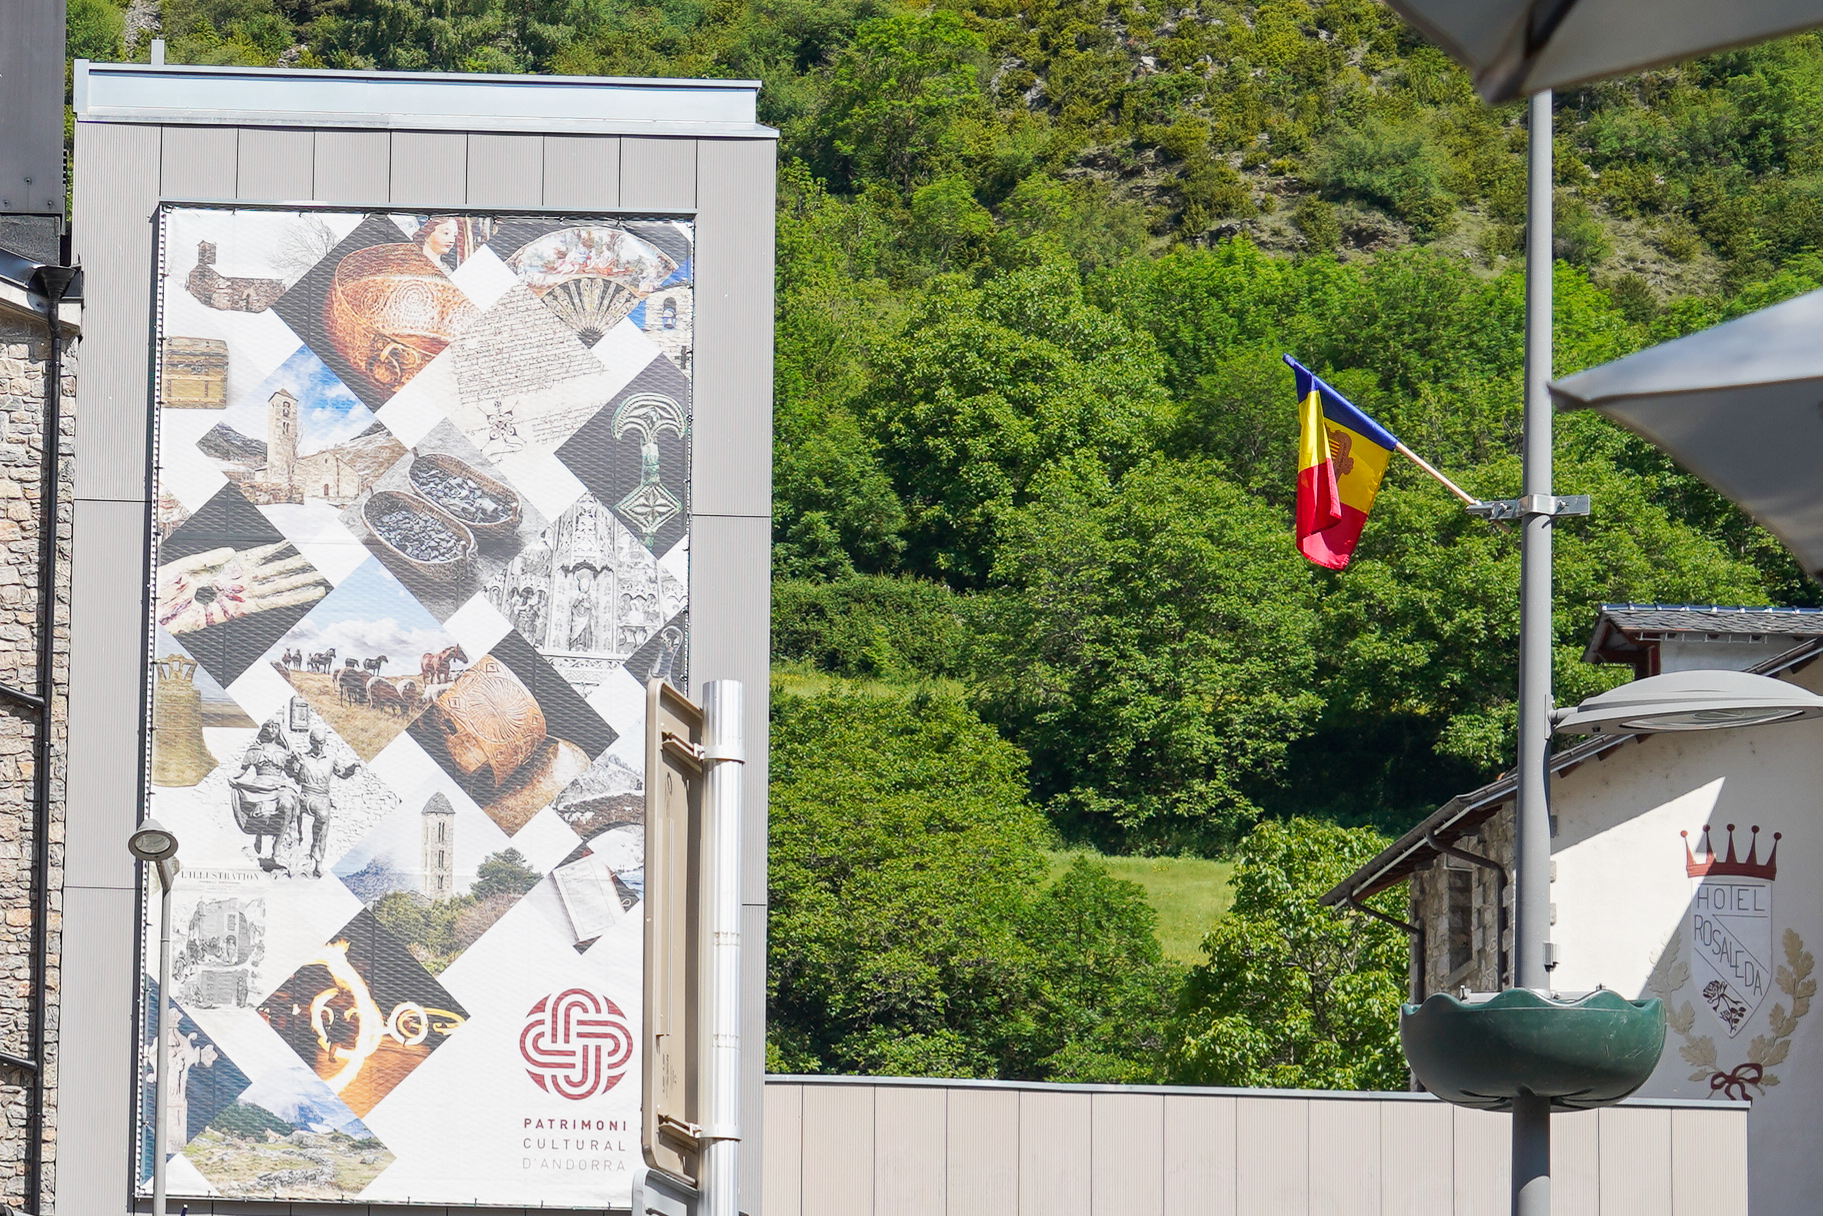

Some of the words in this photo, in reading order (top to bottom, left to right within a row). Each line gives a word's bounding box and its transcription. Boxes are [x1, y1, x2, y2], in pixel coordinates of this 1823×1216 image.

[1697, 885, 1765, 912] HOTEL
[1694, 914, 1763, 997] ROSALEDA
[524, 1118, 626, 1131] PATRIMONI
[523, 1138, 625, 1151] CULTURAL
[522, 1157, 625, 1171] D'ANDORRA
